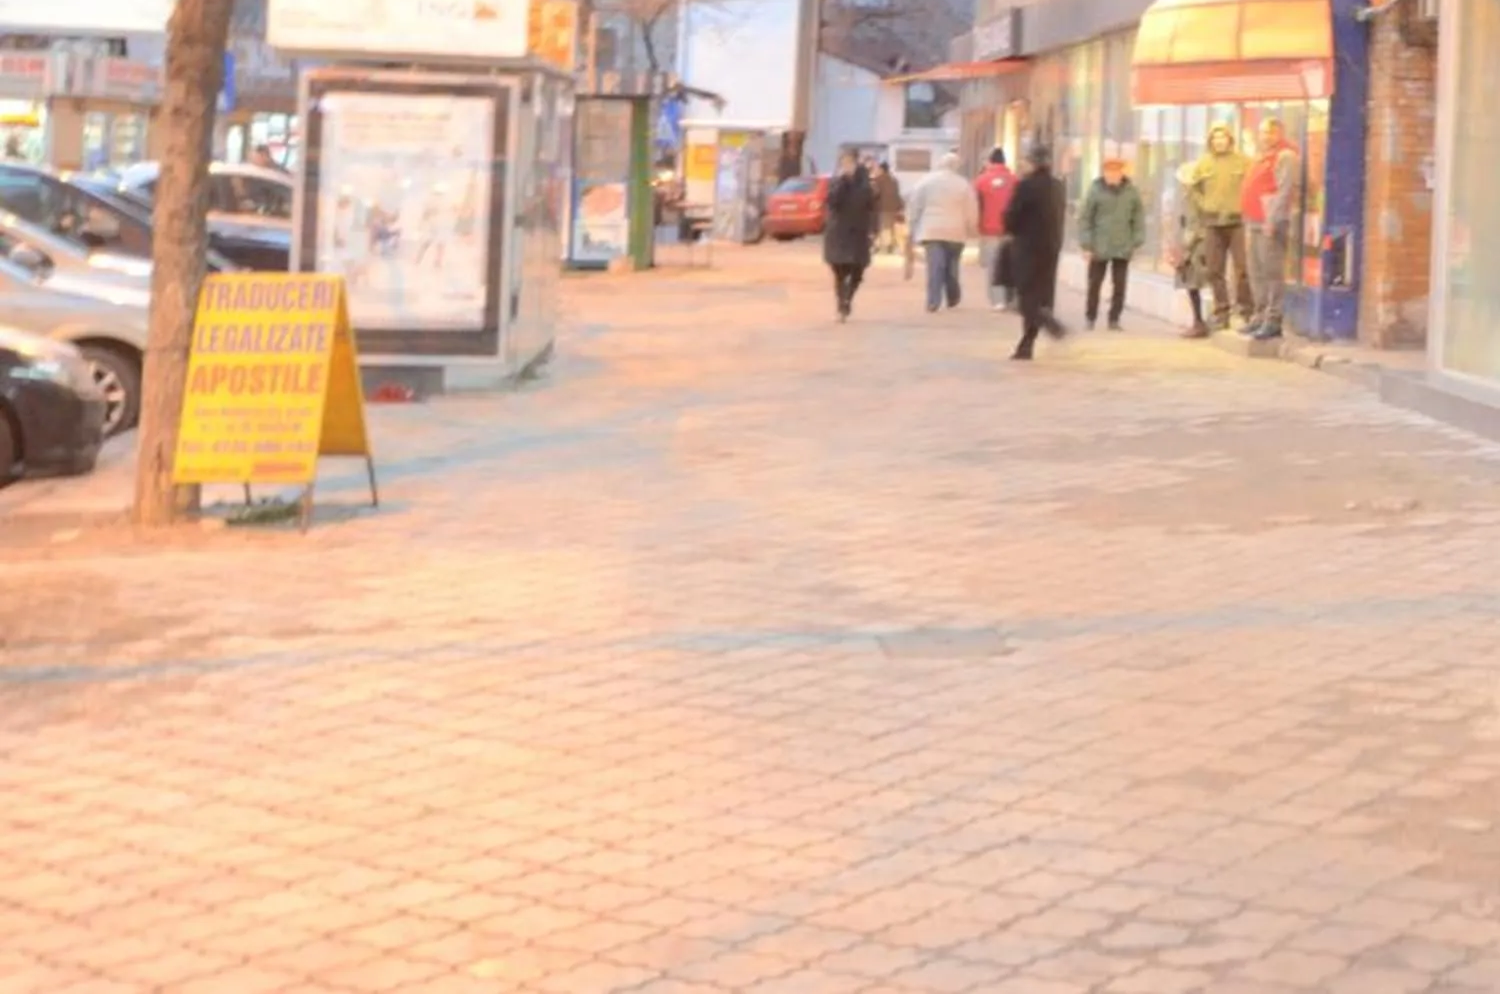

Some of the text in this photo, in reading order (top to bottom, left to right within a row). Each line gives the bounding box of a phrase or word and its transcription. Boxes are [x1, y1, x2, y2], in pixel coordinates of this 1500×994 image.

[204, 279, 335, 312] TRADUCERI
[196, 322, 328, 354] LEGALIZATE
[191, 361, 324, 396] APOSTILE
